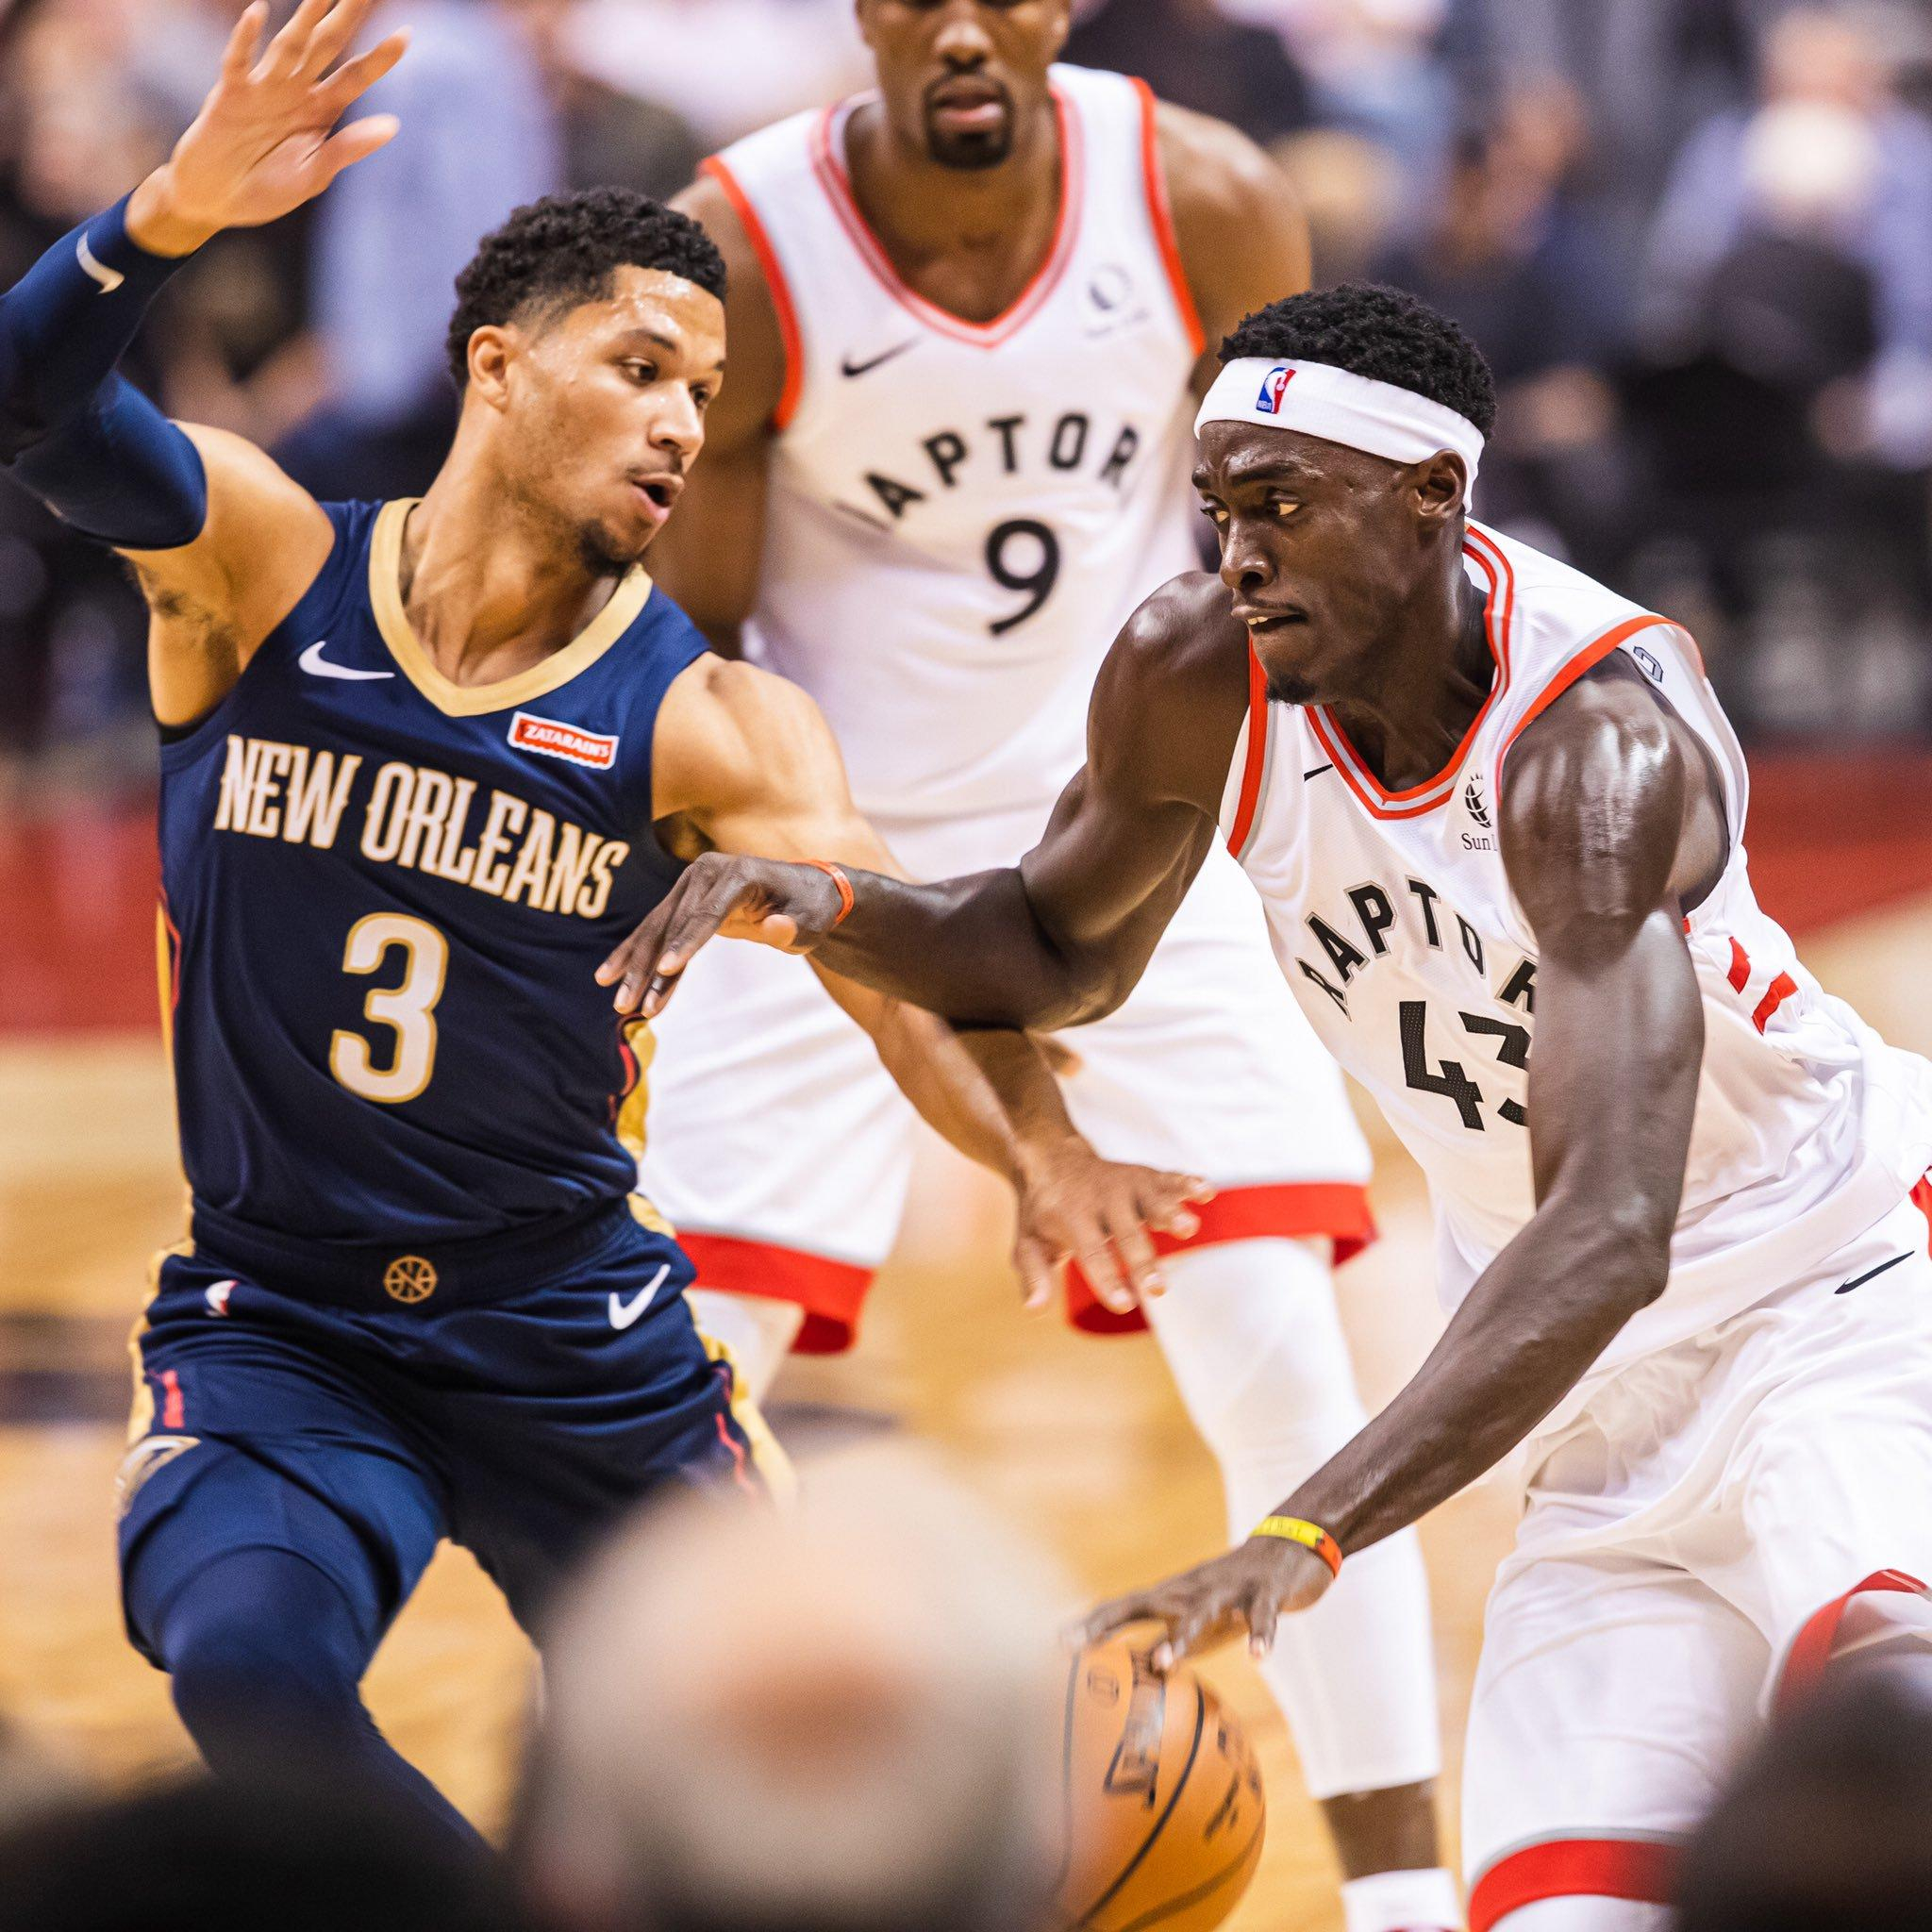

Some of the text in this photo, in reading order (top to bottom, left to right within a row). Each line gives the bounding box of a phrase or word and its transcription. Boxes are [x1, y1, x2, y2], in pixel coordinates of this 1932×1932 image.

[985, 519, 1060, 636] 9
[523, 724, 610, 758] ZATARAIN'S
[214, 735, 630, 919] NEW ORLEANS
[1461, 832, 1491, 851] Sun
[328, 911, 450, 1104] 3
